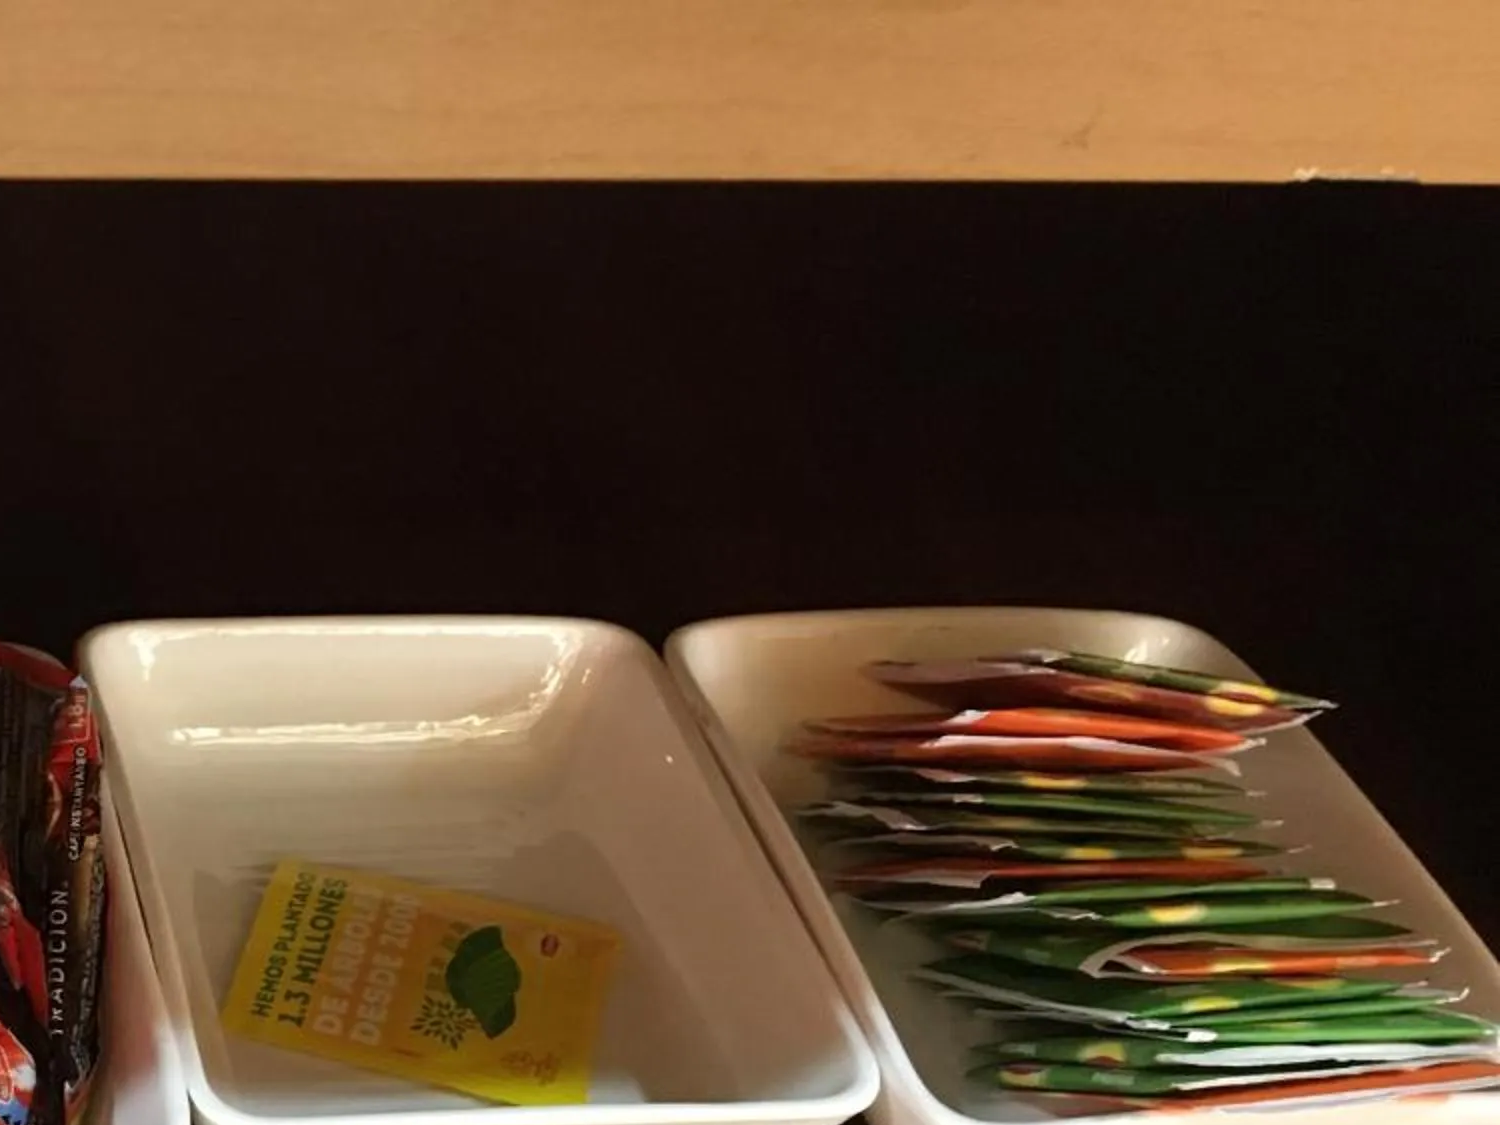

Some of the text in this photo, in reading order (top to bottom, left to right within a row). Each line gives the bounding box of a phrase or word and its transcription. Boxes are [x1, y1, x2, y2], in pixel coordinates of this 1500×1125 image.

[250, 955, 288, 1018] HEMOS
[277, 877, 349, 1028] 1.3 MILLONES
[314, 993, 346, 1036] DE
[349, 951, 404, 1046] DESDE
